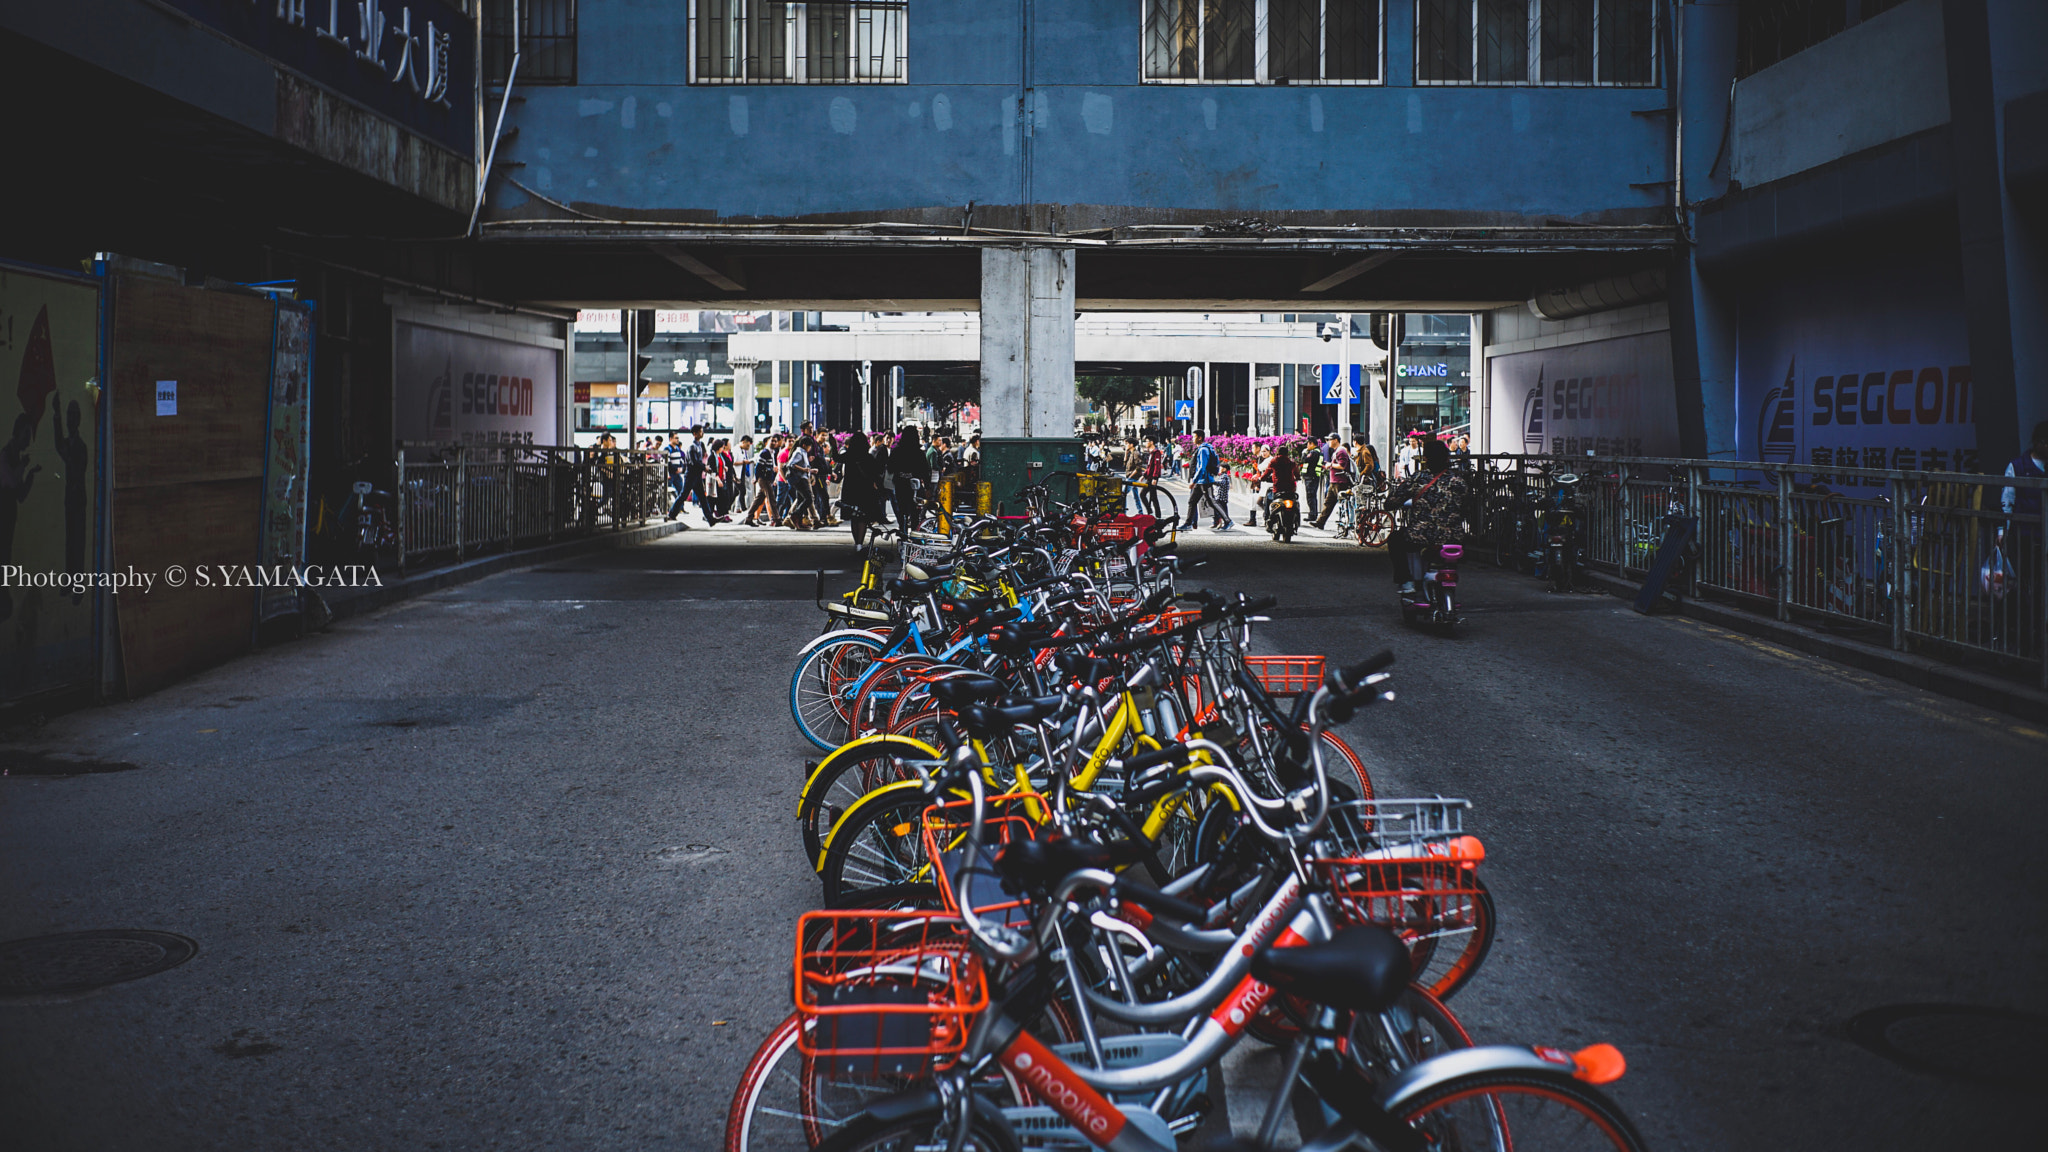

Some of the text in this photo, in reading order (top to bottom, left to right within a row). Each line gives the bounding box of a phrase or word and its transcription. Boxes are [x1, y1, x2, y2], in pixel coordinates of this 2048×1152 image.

[462, 372, 533, 416] SEGCOM
[1552, 373, 1641, 421] SEGCOM
[1812, 366, 1977, 426] SEGCOM
[1094, 748, 1110, 770] ofo
[1159, 797, 1178, 821] ofo
[1029, 1066, 1109, 1134] mobike
